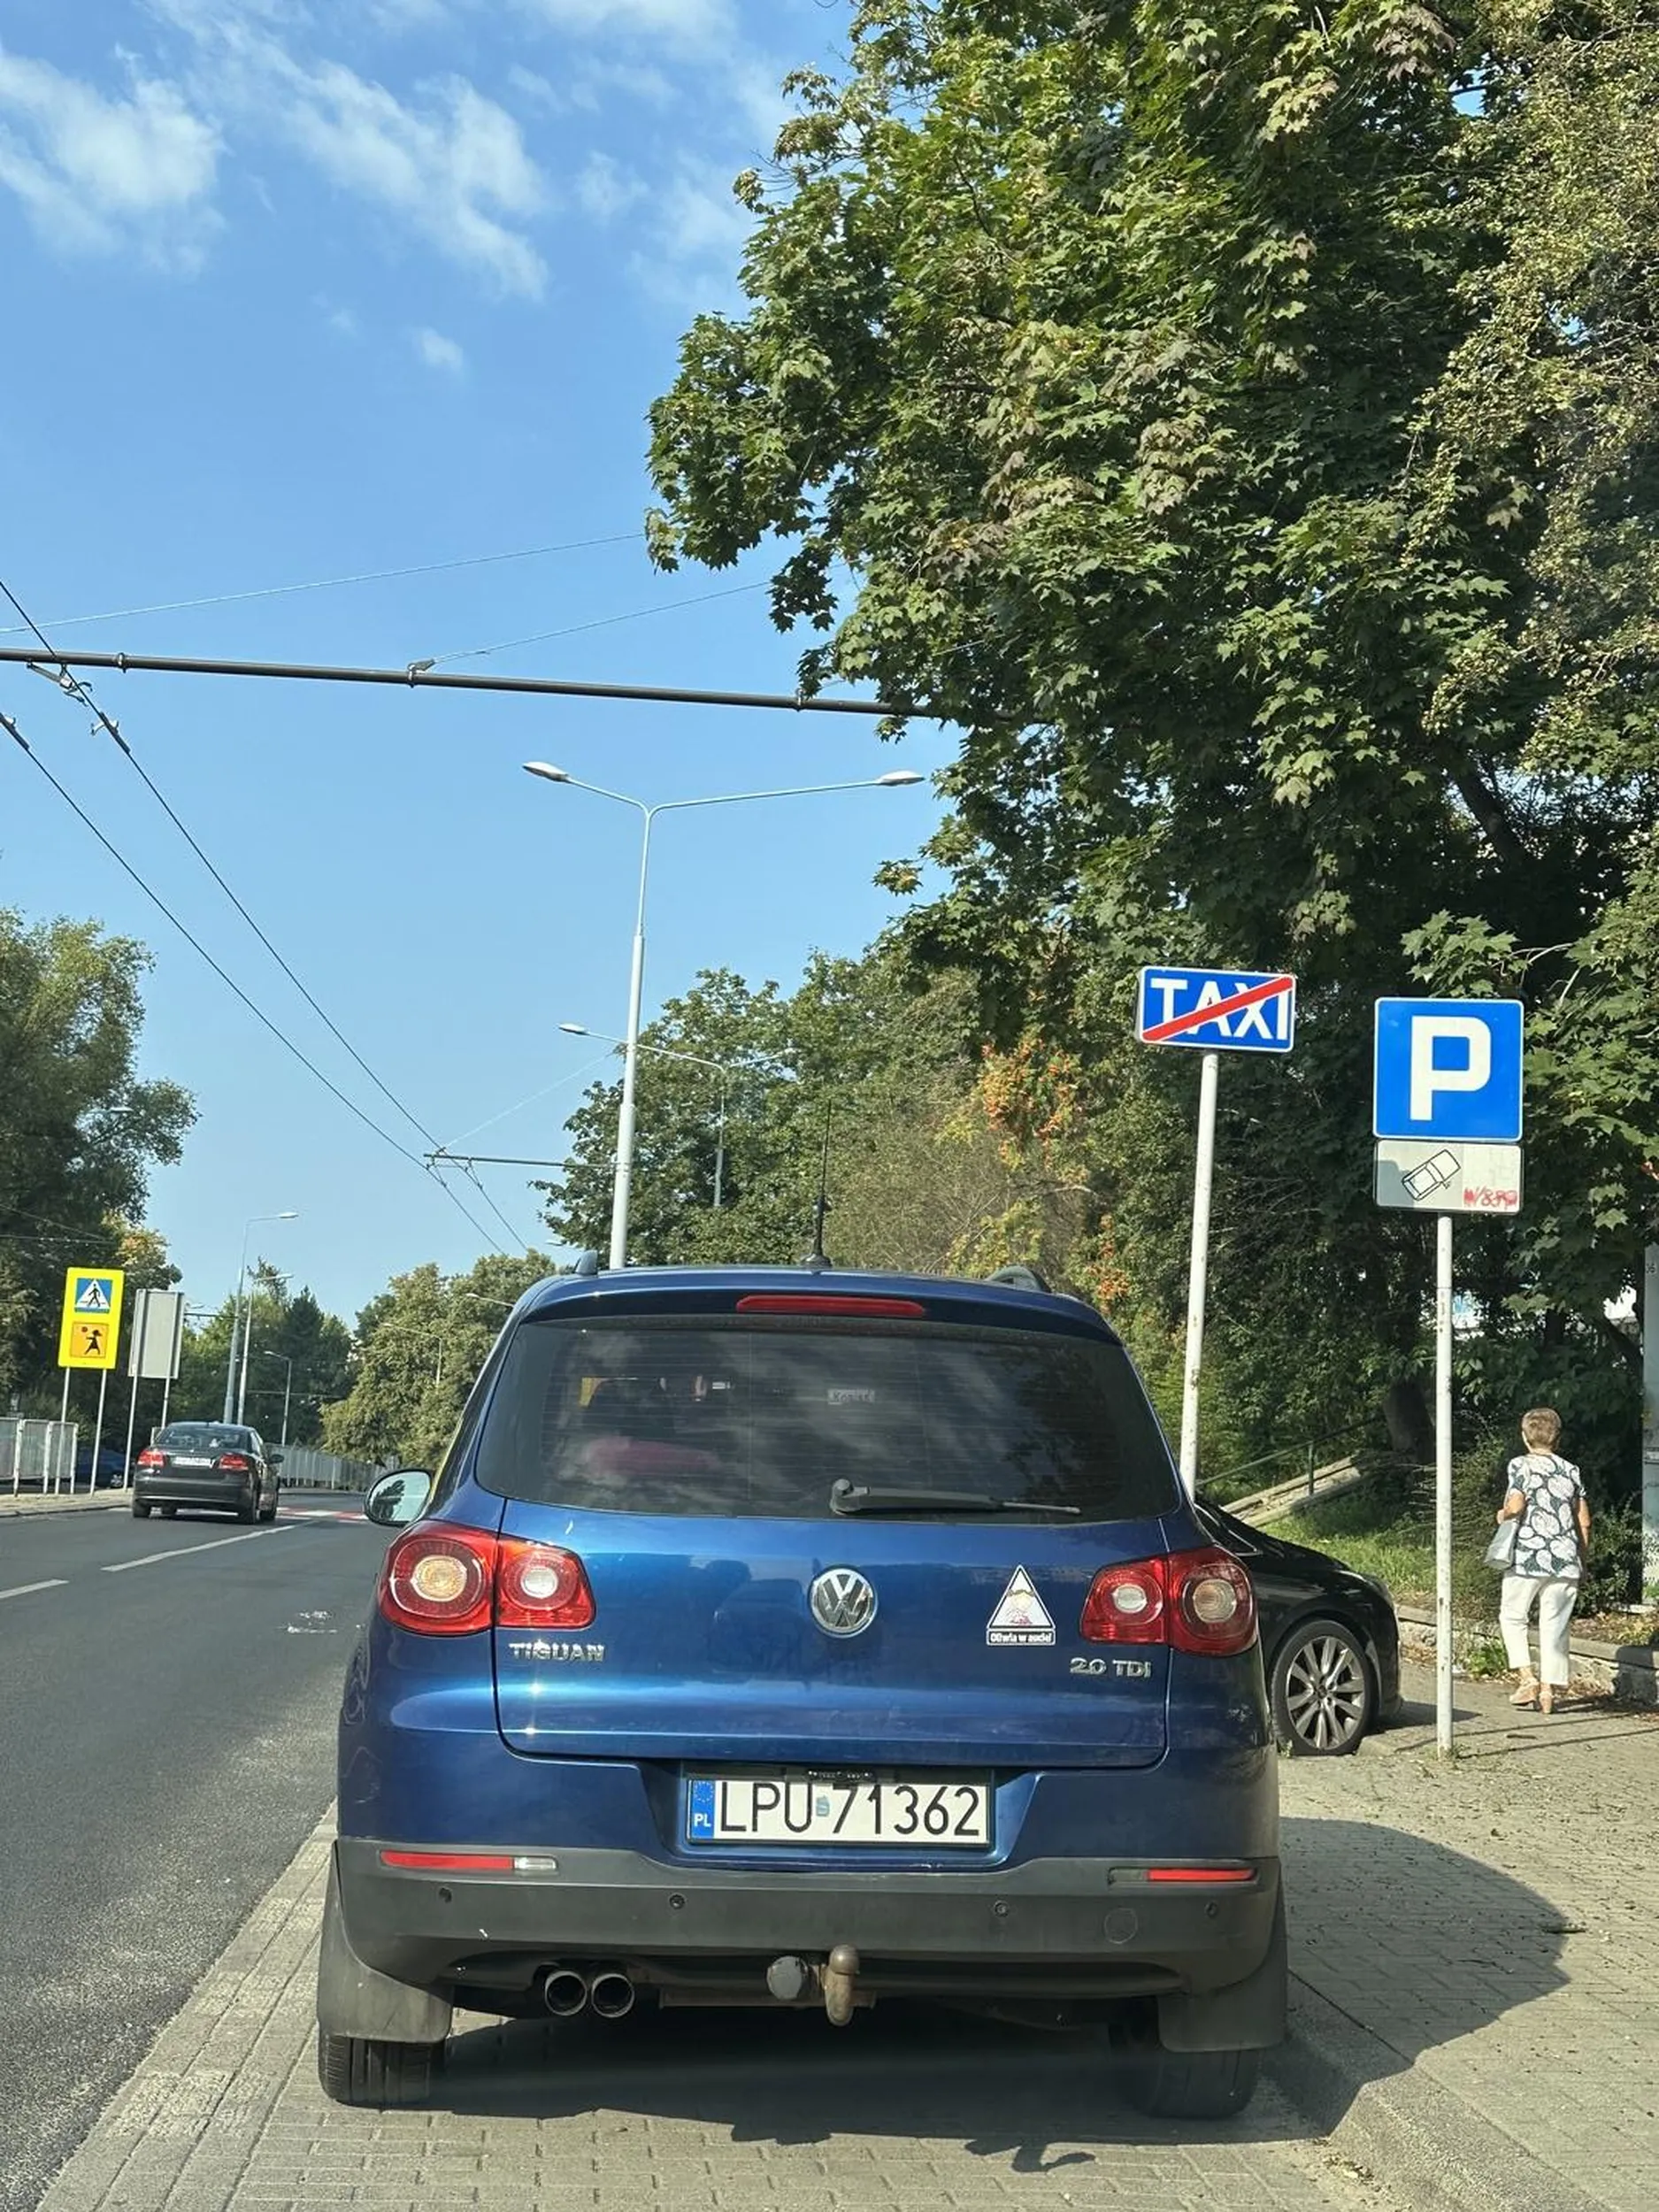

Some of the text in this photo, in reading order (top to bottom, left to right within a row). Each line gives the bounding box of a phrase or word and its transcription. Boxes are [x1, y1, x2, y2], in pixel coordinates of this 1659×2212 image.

[1150, 978, 1289, 1040] TAXI
[1410, 1016, 1491, 1121] P
[508, 1641, 604, 1662] TIGUAN
[1112, 1659, 1152, 1678] TDI
[694, 1814, 711, 1827] PL
[720, 1780, 980, 1836] LPU 71362
